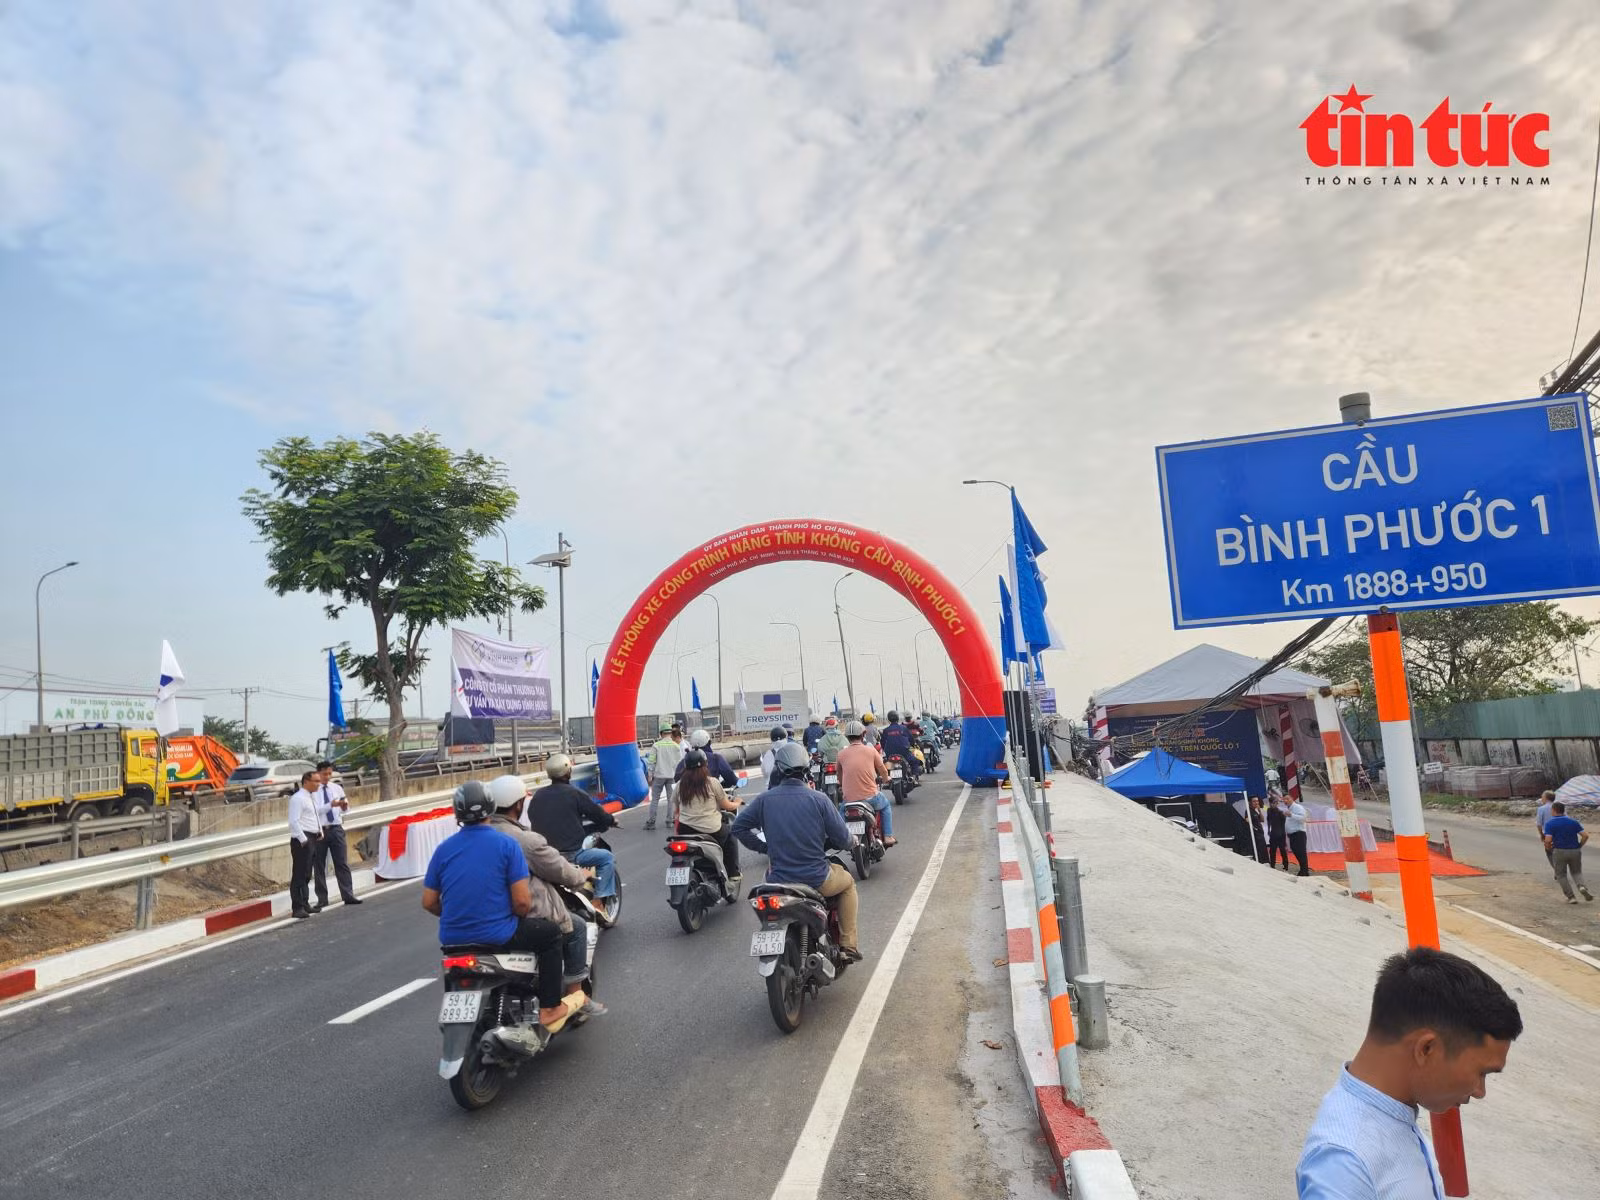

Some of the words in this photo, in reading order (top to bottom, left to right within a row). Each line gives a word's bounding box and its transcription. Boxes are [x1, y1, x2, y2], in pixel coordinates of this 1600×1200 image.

[1321, 433, 1420, 491] CẦU
[714, 537, 728, 547] BAN
[769, 522, 793, 531] THÀNH
[793, 521, 809, 530] PHỐ
[824, 523, 838, 532] CHÍ
[837, 527, 857, 537] MINH
[1215, 514, 1329, 567] BÌNH
[1344, 489, 1518, 554] PHƯỚC
[1531, 494, 1550, 535] 1
[617, 612, 651, 659] THÔNG
[644, 596, 662, 616] XE
[659, 567, 693, 600] CÔNG
[689, 546, 730, 575] TRÌNH
[731, 534, 772, 555] NÂNG
[774, 530, 806, 545] TĨNH
[810, 532, 862, 554] KHÔNG
[891, 560, 926, 589] BÌNH
[920, 584, 962, 630] PHƯỚC
[953, 626, 967, 637] 1
[1281, 578, 1333, 606] Km
[1343, 562, 1488, 601] 1888+950
[54, 708, 76, 719] AN
[84, 705, 110, 720] PHÚ
[1201, 742, 1223, 751] QUỐC
